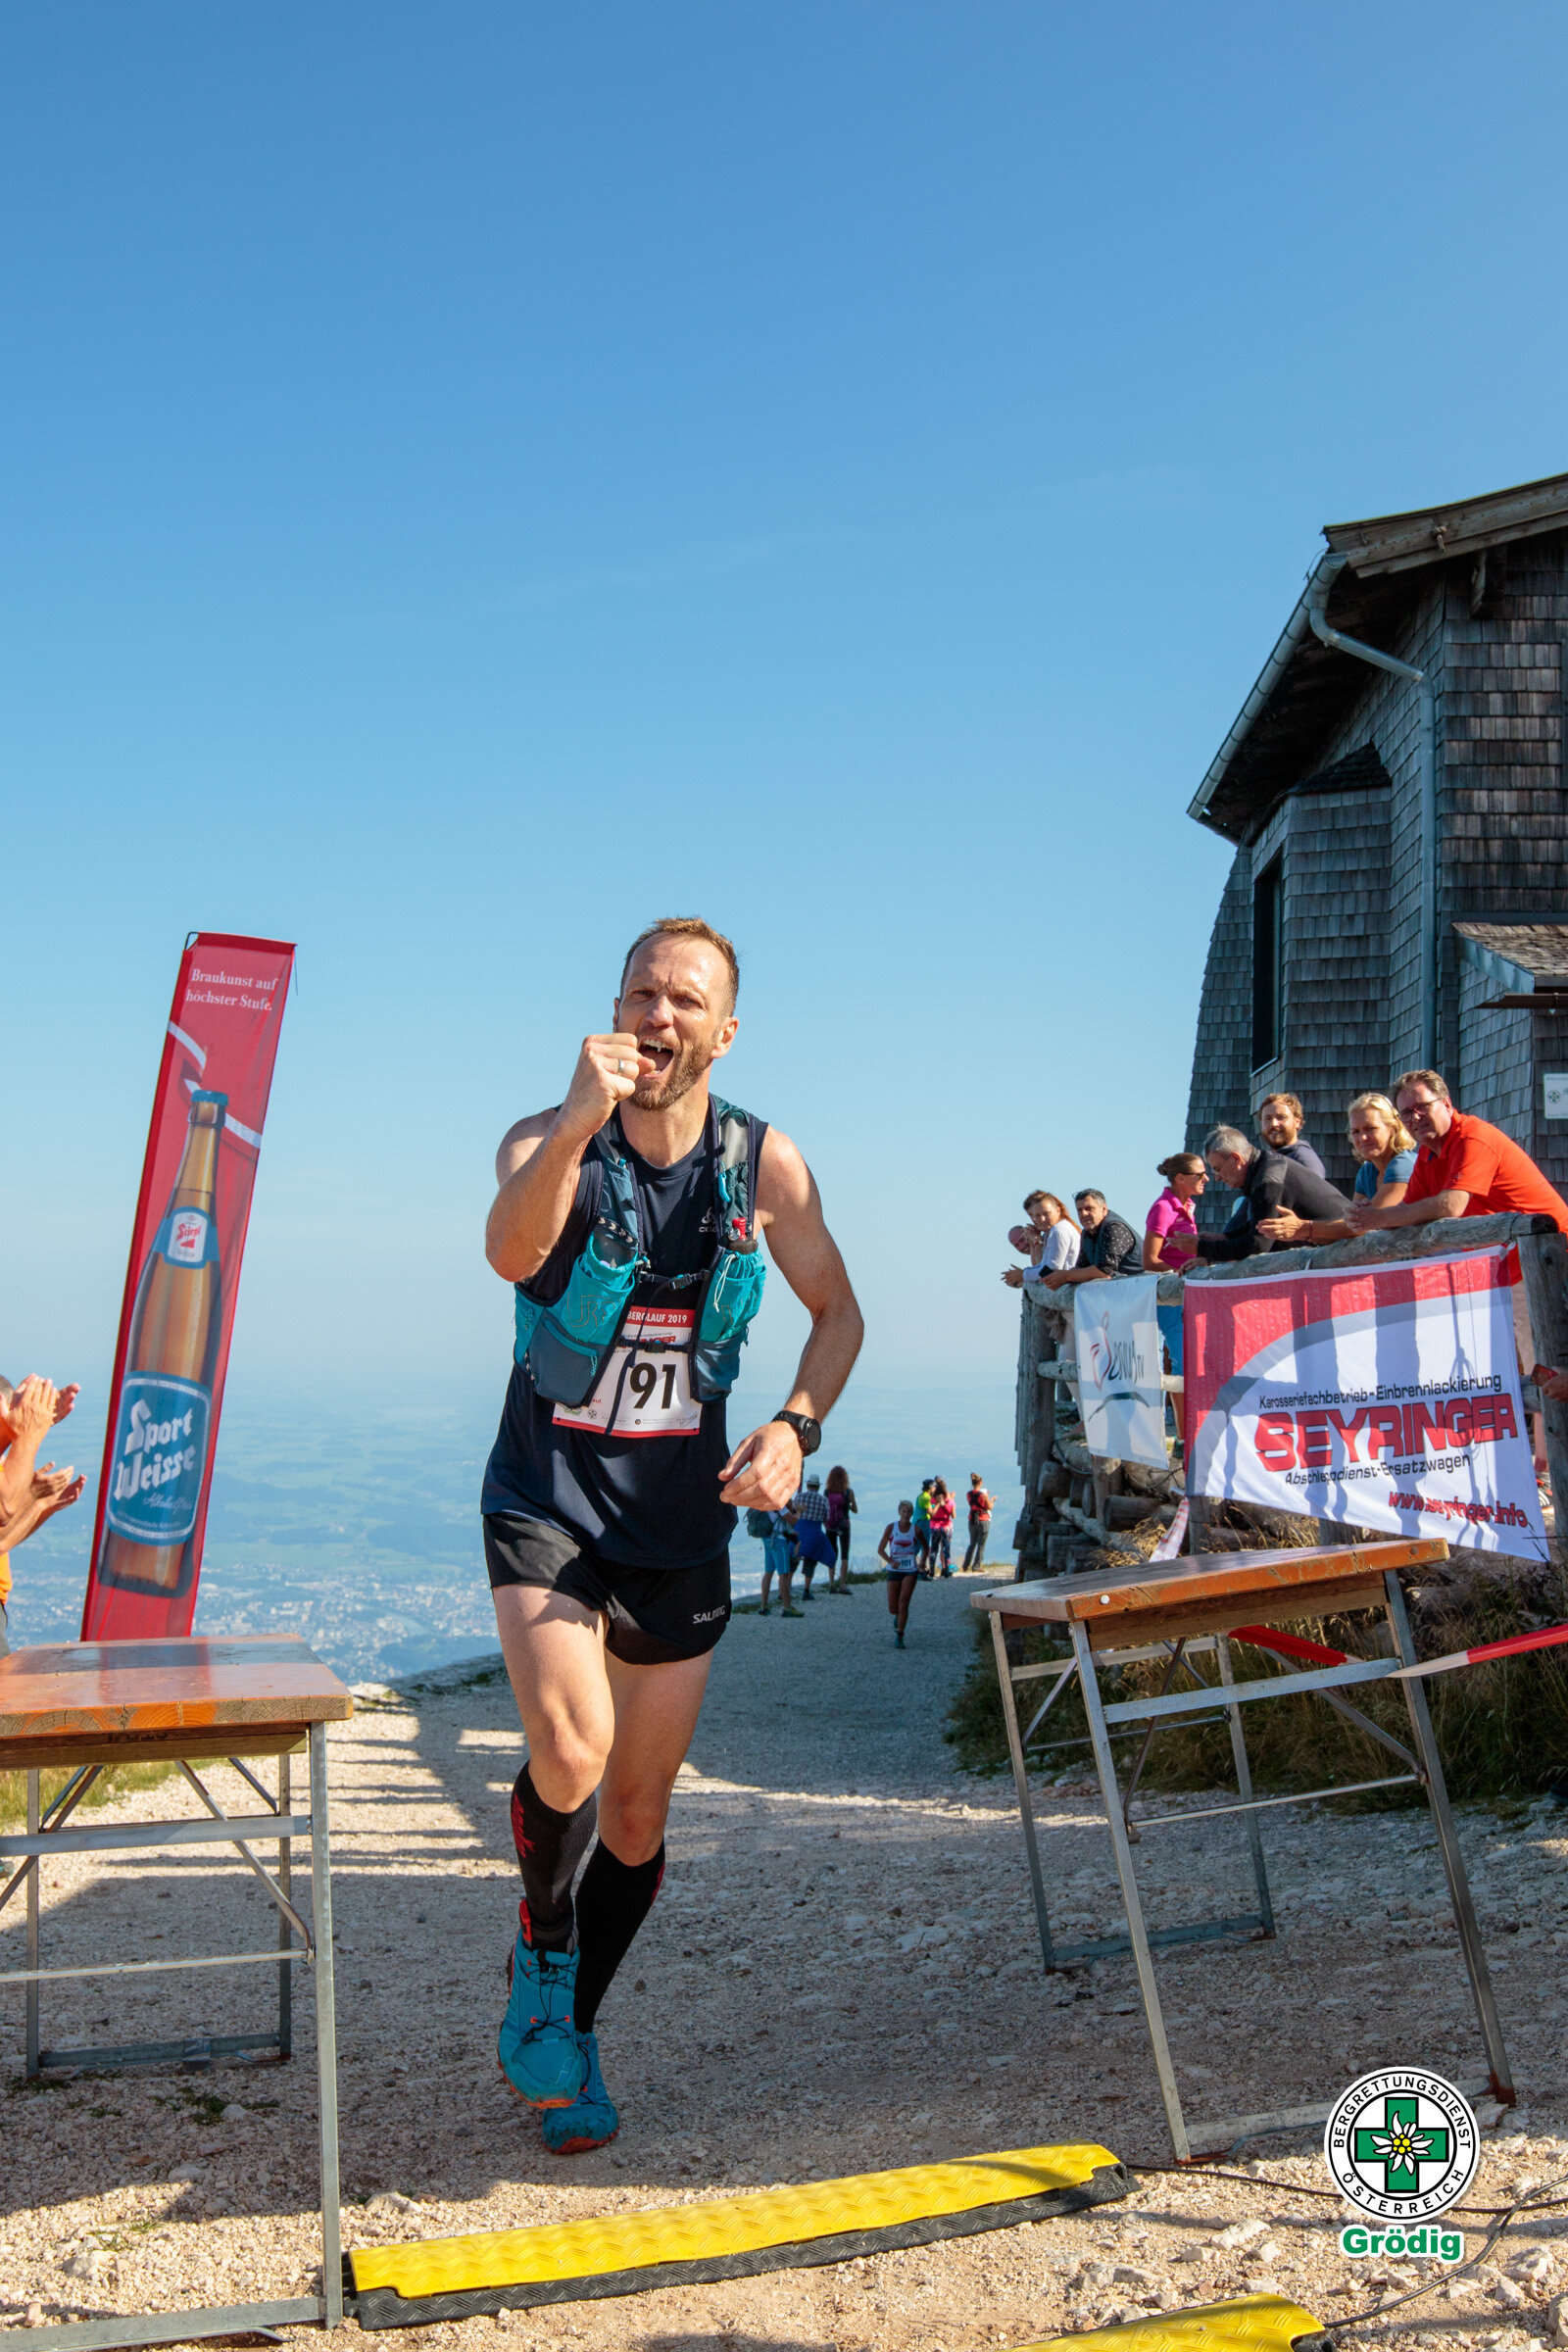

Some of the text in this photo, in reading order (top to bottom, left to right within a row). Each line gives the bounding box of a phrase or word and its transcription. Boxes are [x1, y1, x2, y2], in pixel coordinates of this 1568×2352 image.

[185, 989, 272, 1010] höchster Stufe.
[191, 968, 279, 991] Braukunst auf
[667, 1314, 687, 1323] 2019
[629, 1362, 677, 1409] 91
[124, 1398, 193, 1455] Sport
[1254, 1393, 1518, 1473] SEYRINGER
[114, 1445, 196, 1501] Weisse
[1389, 1492, 1528, 1528] www.seyringer.info
